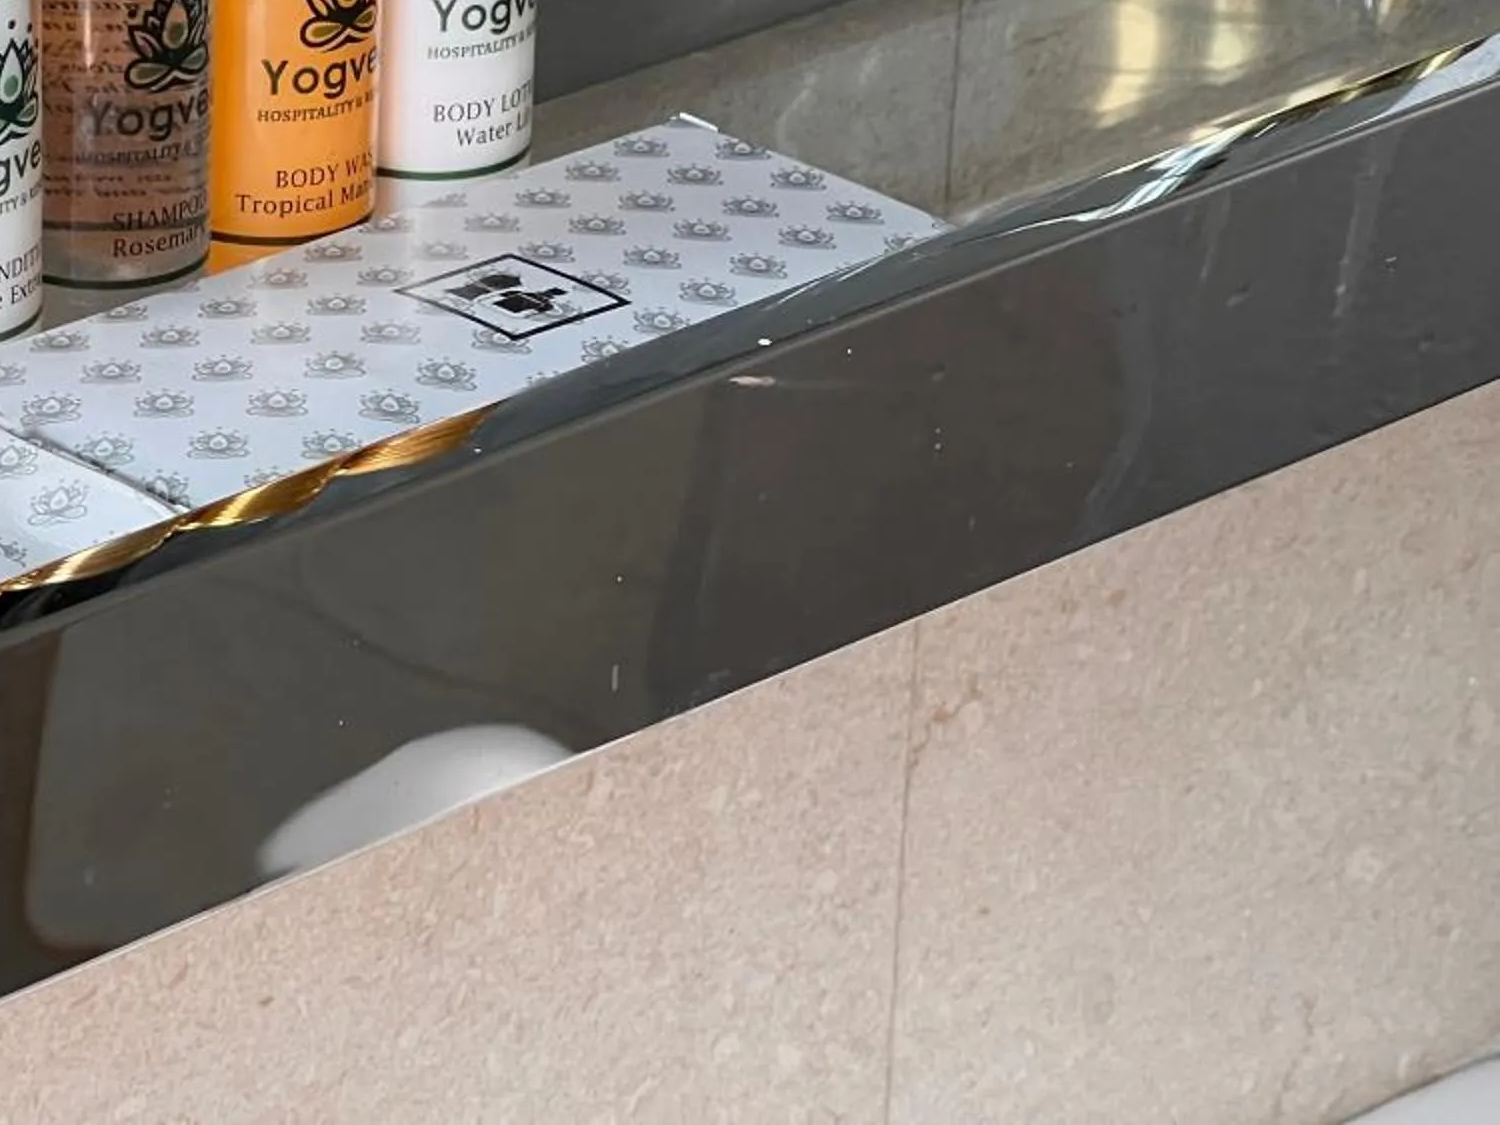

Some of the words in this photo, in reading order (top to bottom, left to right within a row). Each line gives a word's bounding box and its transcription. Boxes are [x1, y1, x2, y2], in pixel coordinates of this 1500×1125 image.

[427, 34, 517, 60] HOSPITALITY
[257, 100, 351, 122] HOSPITALITY
[432, 98, 495, 123] BODY
[456, 122, 513, 147] Water
[276, 163, 339, 189] BODY
[235, 189, 334, 218] Tropical
